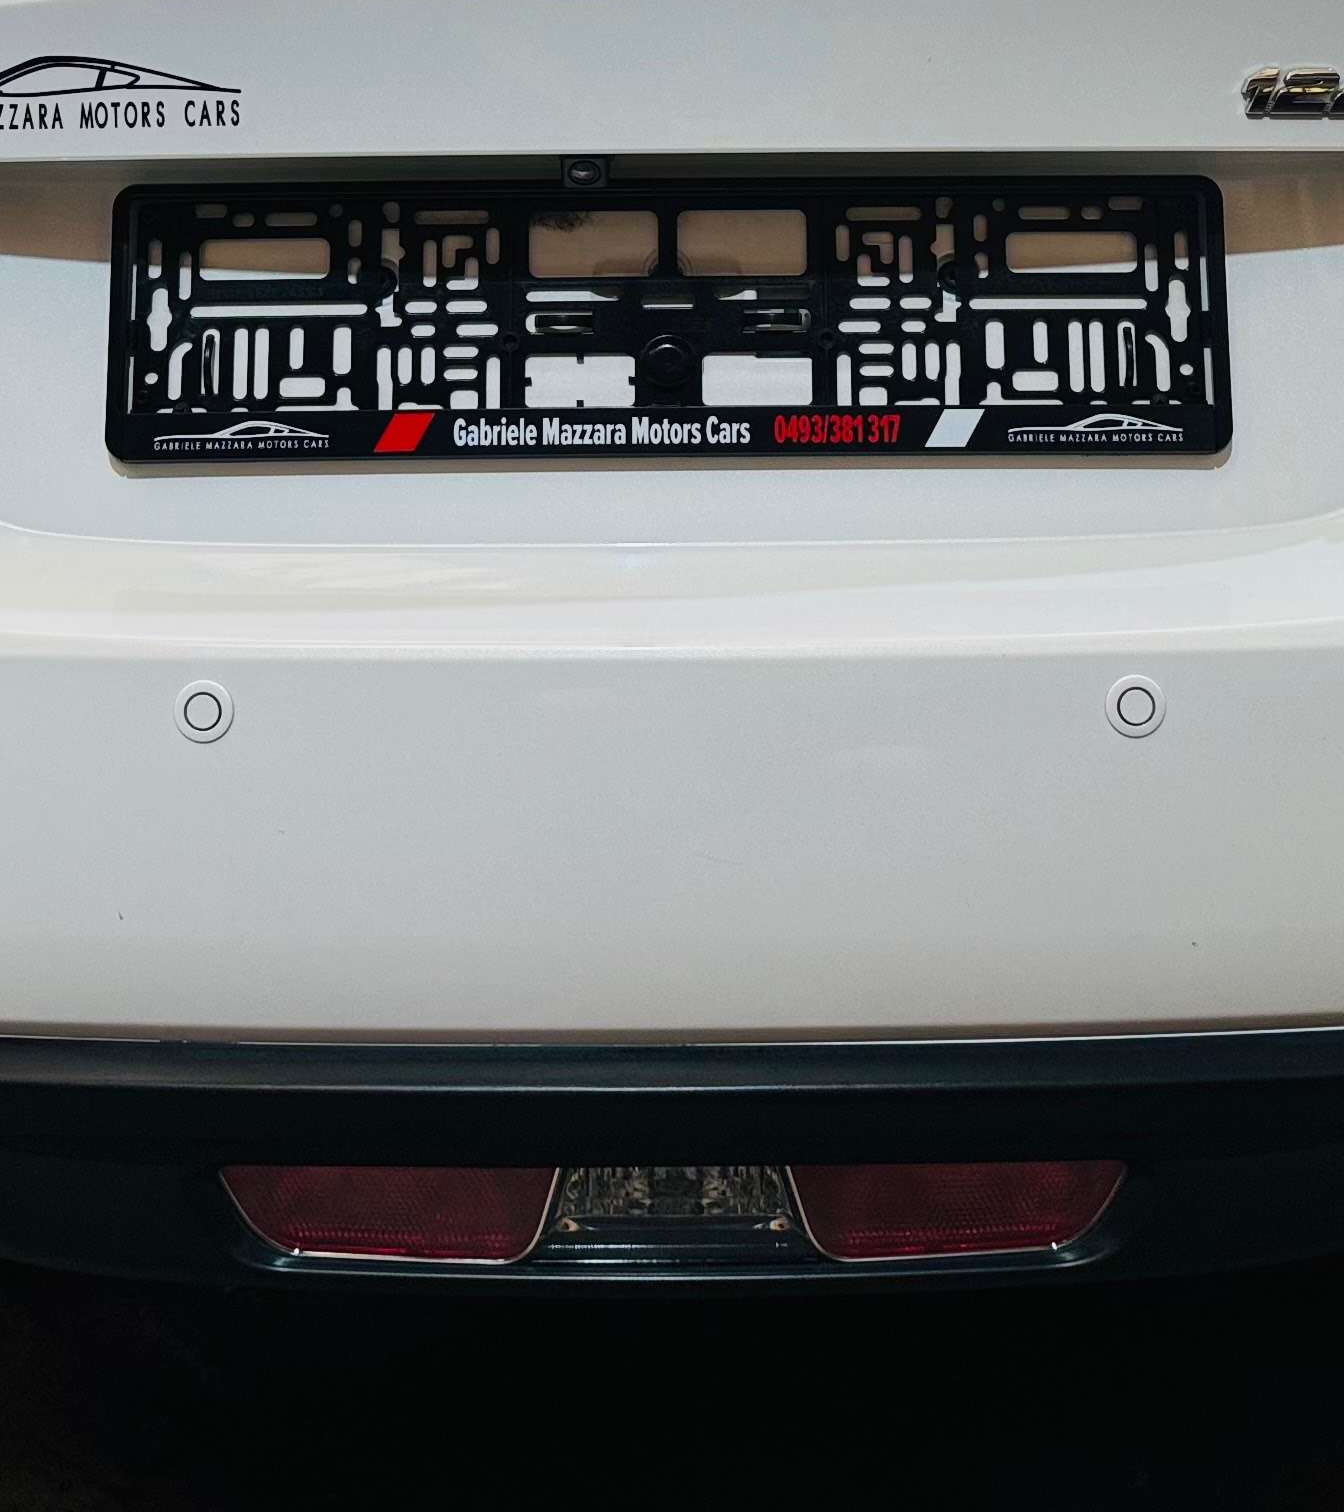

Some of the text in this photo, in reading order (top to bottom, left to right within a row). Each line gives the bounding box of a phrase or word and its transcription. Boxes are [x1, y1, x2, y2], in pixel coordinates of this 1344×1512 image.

[80, 101, 166, 129] MOTORS
[184, 100, 241, 128] CARS
[453, 413, 902, 447] Gabriele Mazzara Motors Cars 0493/381 317
[1008, 432, 1184, 443] GABRIELE MAZZARA MOTORS CARS
[154, 439, 329, 451] GABRIELE MAZZARA MOTORS CARS
